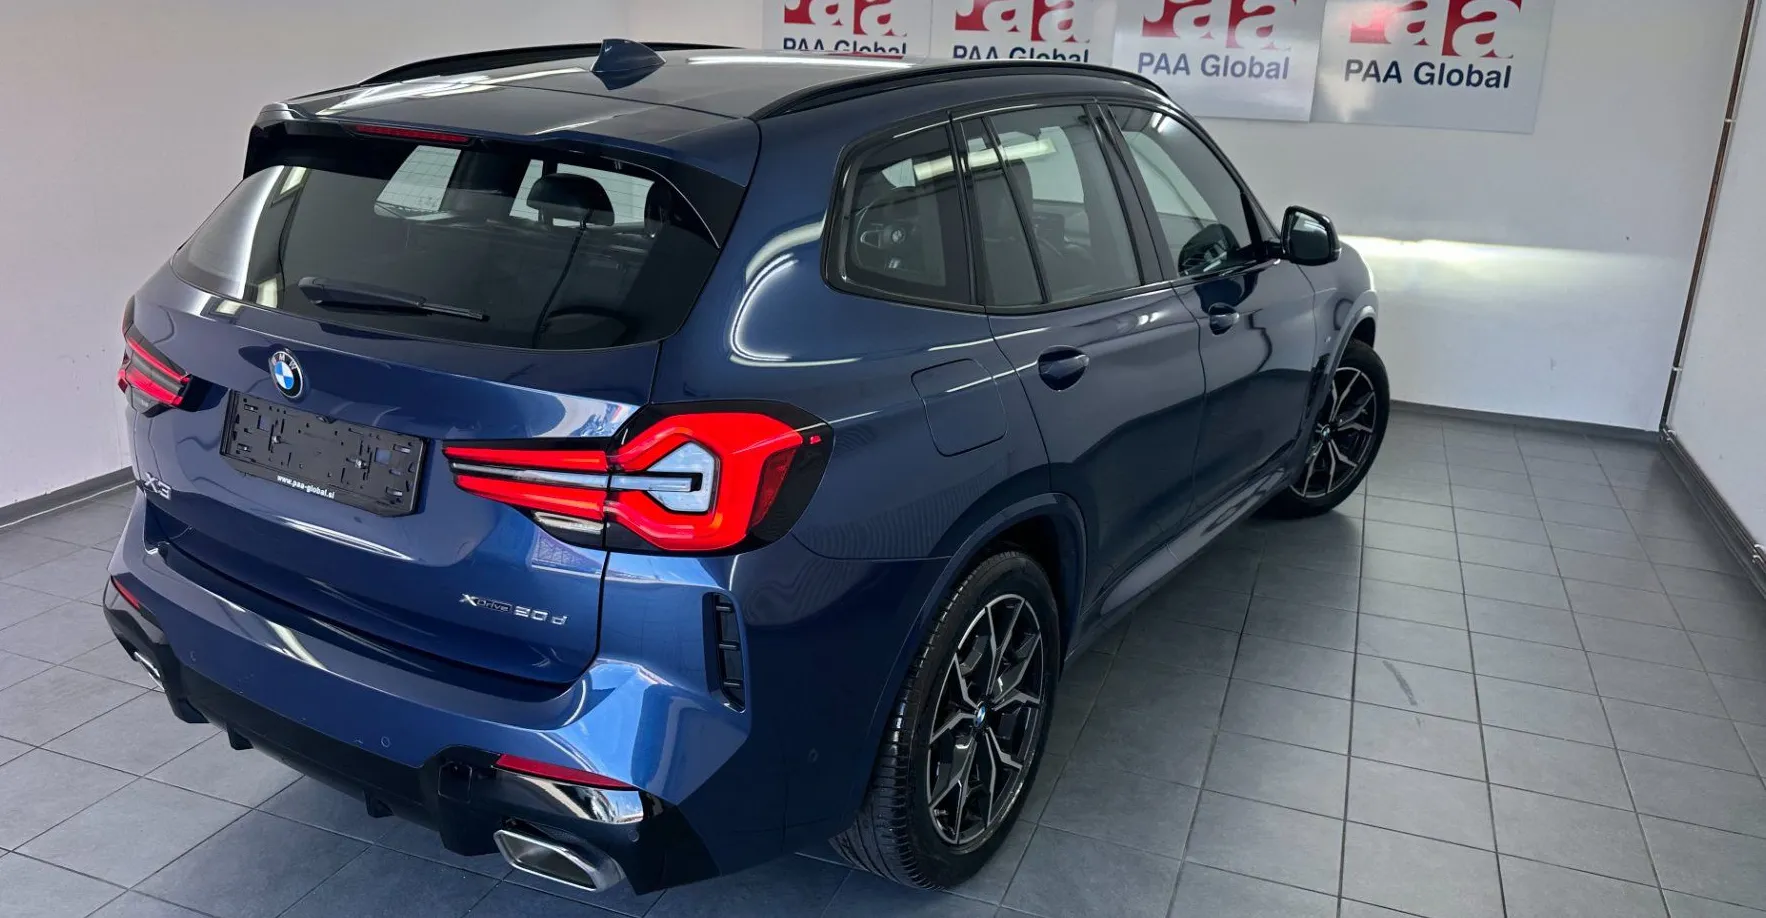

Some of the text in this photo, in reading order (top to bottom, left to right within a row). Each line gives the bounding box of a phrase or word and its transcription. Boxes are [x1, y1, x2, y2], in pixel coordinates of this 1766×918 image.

[953, 45, 999, 60] PAA
[1137, 52, 1290, 80] PAA Global
[1344, 58, 1512, 89] PAA Global
[144, 471, 171, 500] X3
[276, 475, 336, 499] www.paa-global.si
